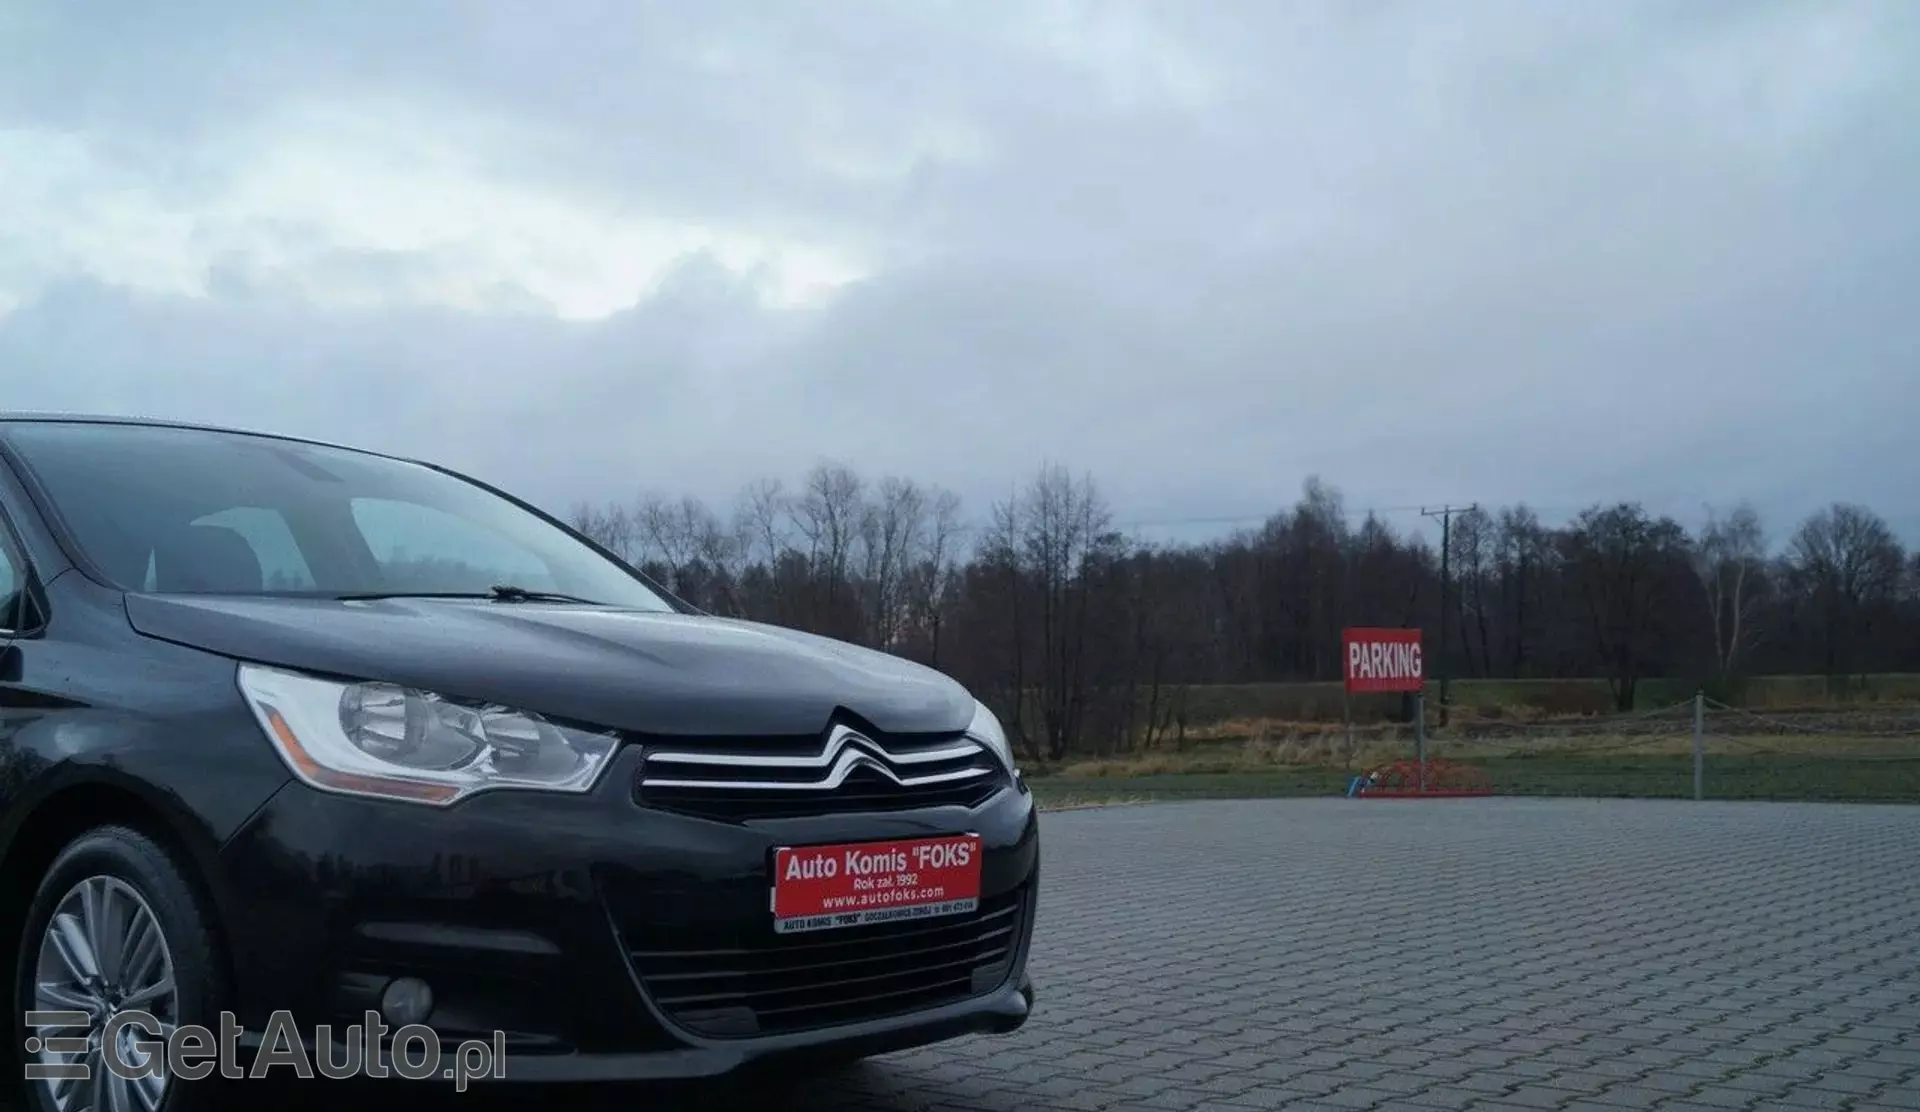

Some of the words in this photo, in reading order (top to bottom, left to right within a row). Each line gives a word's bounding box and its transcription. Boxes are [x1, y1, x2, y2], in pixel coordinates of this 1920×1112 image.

[1348, 642, 1422, 679] PARKING
[785, 854, 837, 881] Auto
[845, 848, 907, 876] Komis
[912, 842, 977, 869] "FOKS"
[854, 877, 874, 890] Rok
[896, 873, 918, 886] 1992
[822, 886, 944, 909] www.autofoks.com
